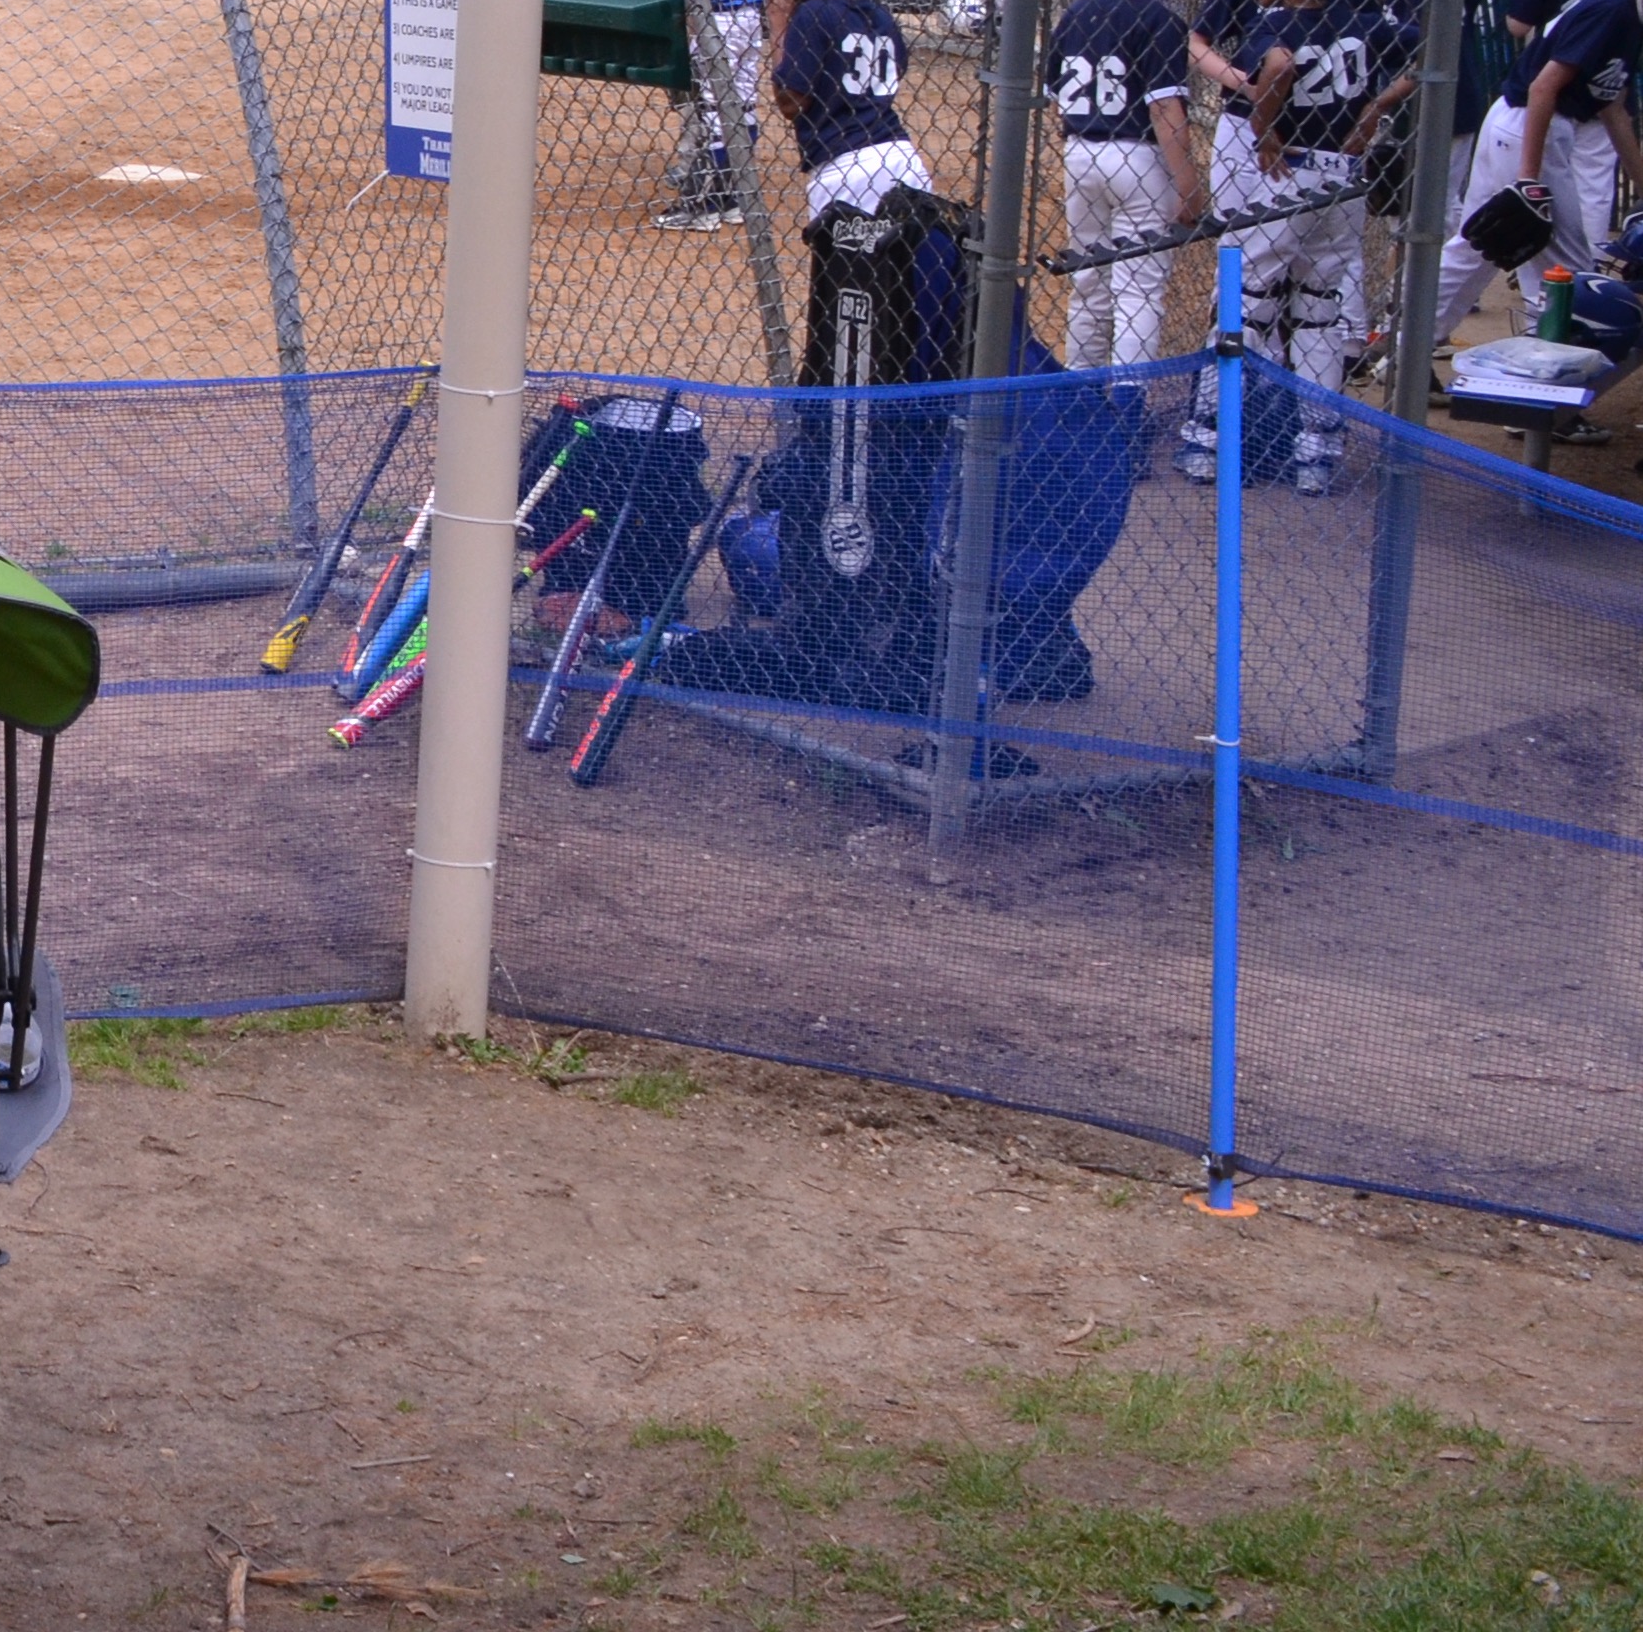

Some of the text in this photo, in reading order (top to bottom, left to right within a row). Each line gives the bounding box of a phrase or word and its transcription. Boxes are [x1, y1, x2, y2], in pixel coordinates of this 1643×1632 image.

[402, 23, 438, 39] COACHES
[440, 27, 455, 40] ARE
[402, 53, 437, 68] UMPIRES
[438, 57, 453, 70] ARE
[840, 31, 899, 97] 30
[1292, 36, 1367, 107] 20
[402, 83, 419, 96] YOU
[421, 85, 433, 97] DO
[435, 87, 452, 99] NOT
[1058, 55, 1127, 117] 26
[401, 97, 427, 112] MAJOR
